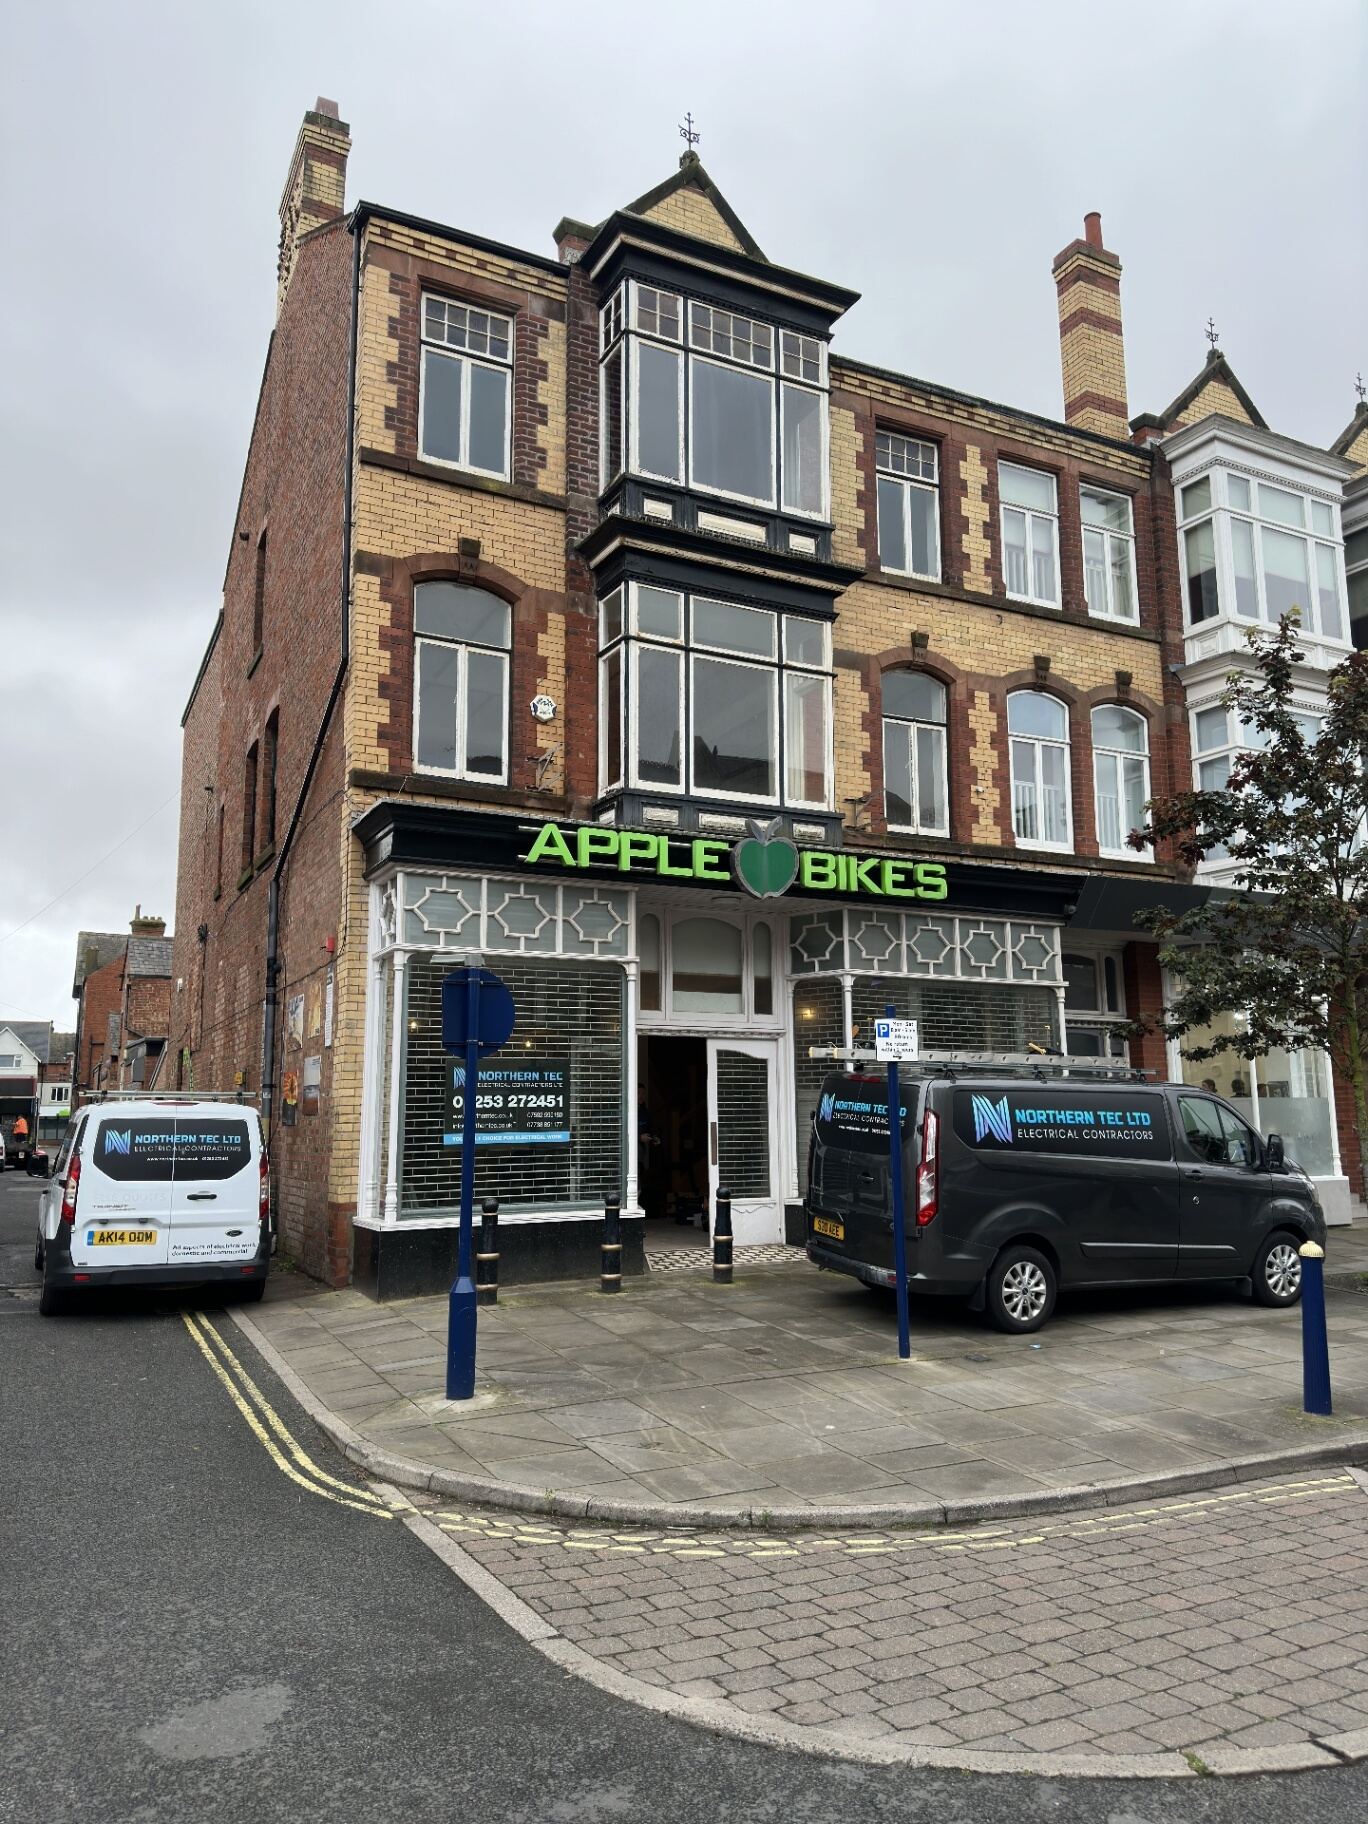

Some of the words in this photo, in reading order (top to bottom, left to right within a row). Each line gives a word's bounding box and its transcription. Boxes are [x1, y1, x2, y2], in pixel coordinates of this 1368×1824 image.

[524, 823, 731, 881] APPLE
[800, 850, 948, 900] BIKES
[478, 1071, 540, 1081] NORTHERN
[543, 1071, 563, 1081] TEC
[452, 1094, 504, 1109] 0253
[507, 1094, 564, 1109] 272451
[834, 1100, 871, 1113] NORTHERN
[873, 1104, 889, 1115] TEC
[1015, 1109, 1094, 1125] NORTHERN
[1097, 1111, 1124, 1125] TEC
[1126, 1111, 1151, 1126] LTD
[135, 1134, 197, 1144] NORTHERN
[200, 1134, 220, 1144] TEC
[222, 1135, 241, 1144] LTD
[1017, 1128, 1079, 1139] ELECTRICAL
[1082, 1129, 1153, 1140] CONTRACTORS
[134, 1145, 183, 1153] ELECTRICAL
[98, 1231, 125, 1243] AK14
